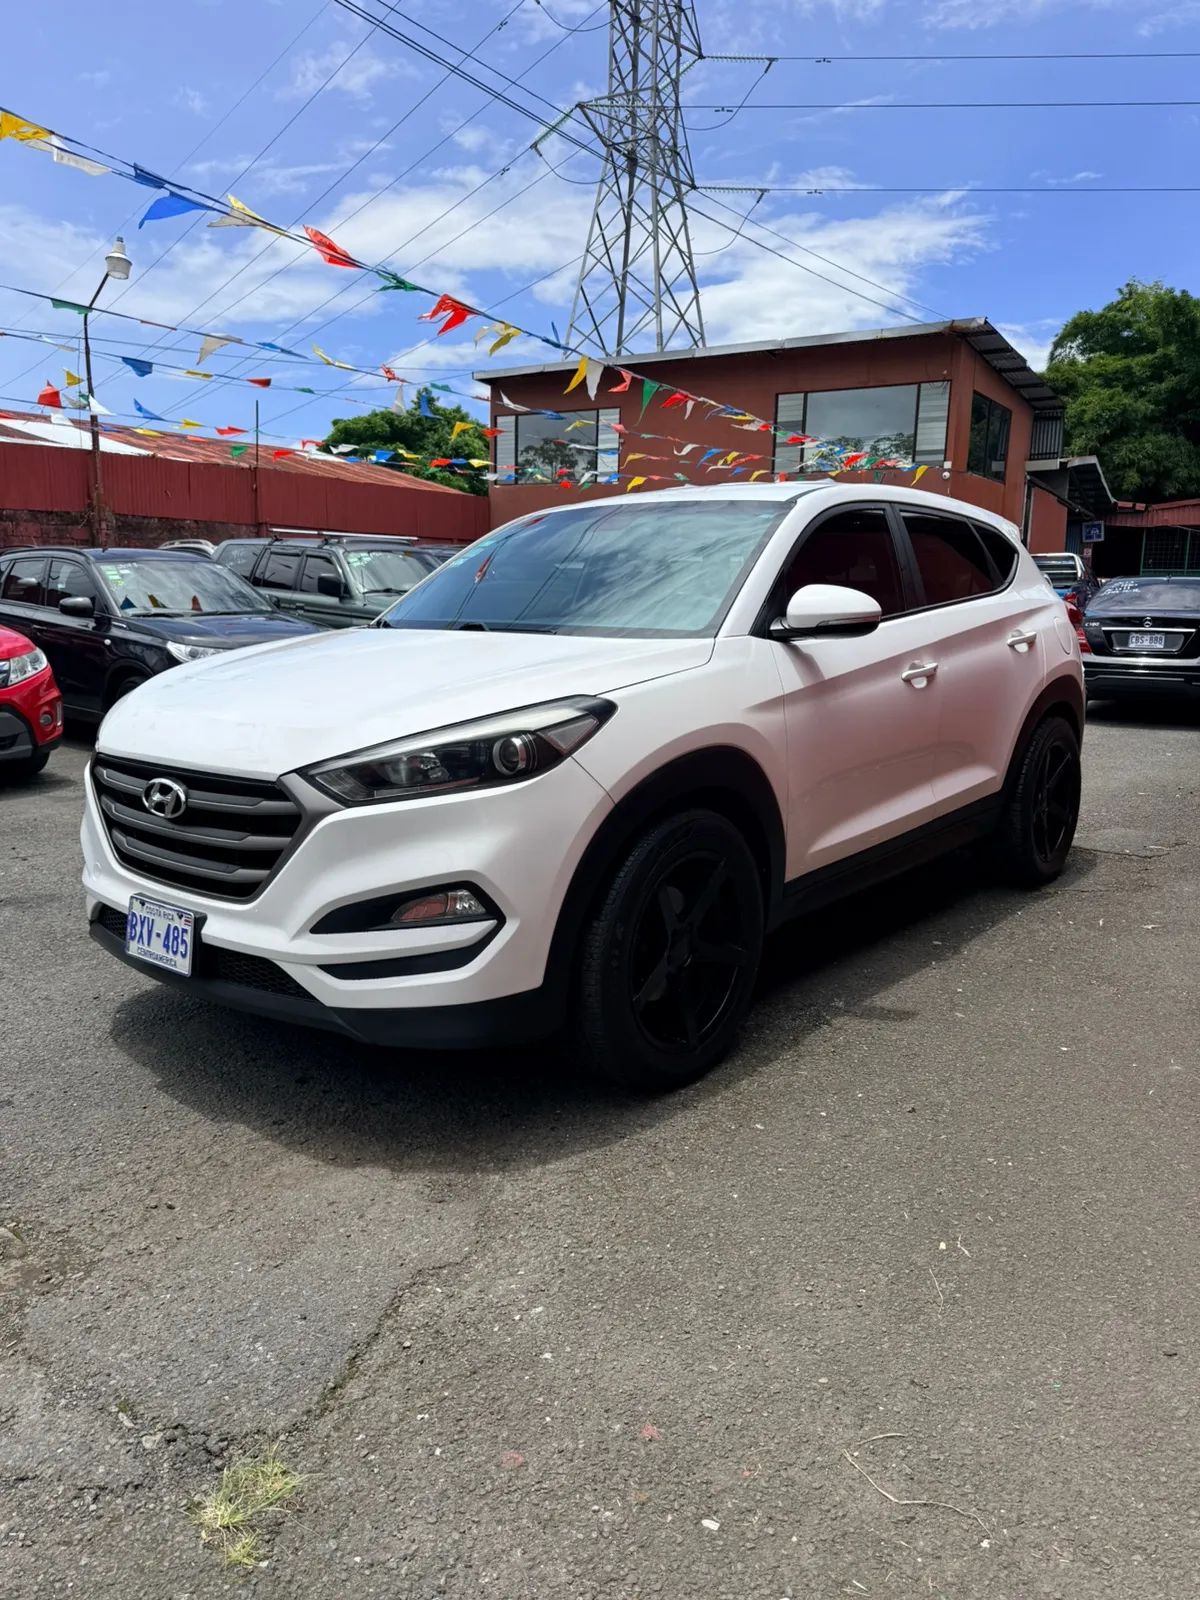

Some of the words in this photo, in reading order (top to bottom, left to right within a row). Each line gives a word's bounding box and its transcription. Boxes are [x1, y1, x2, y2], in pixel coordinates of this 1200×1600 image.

[145, 904, 161, 917] COSTA
[163, 910, 175, 921] RICA
[129, 911, 188, 959] BXV-485
